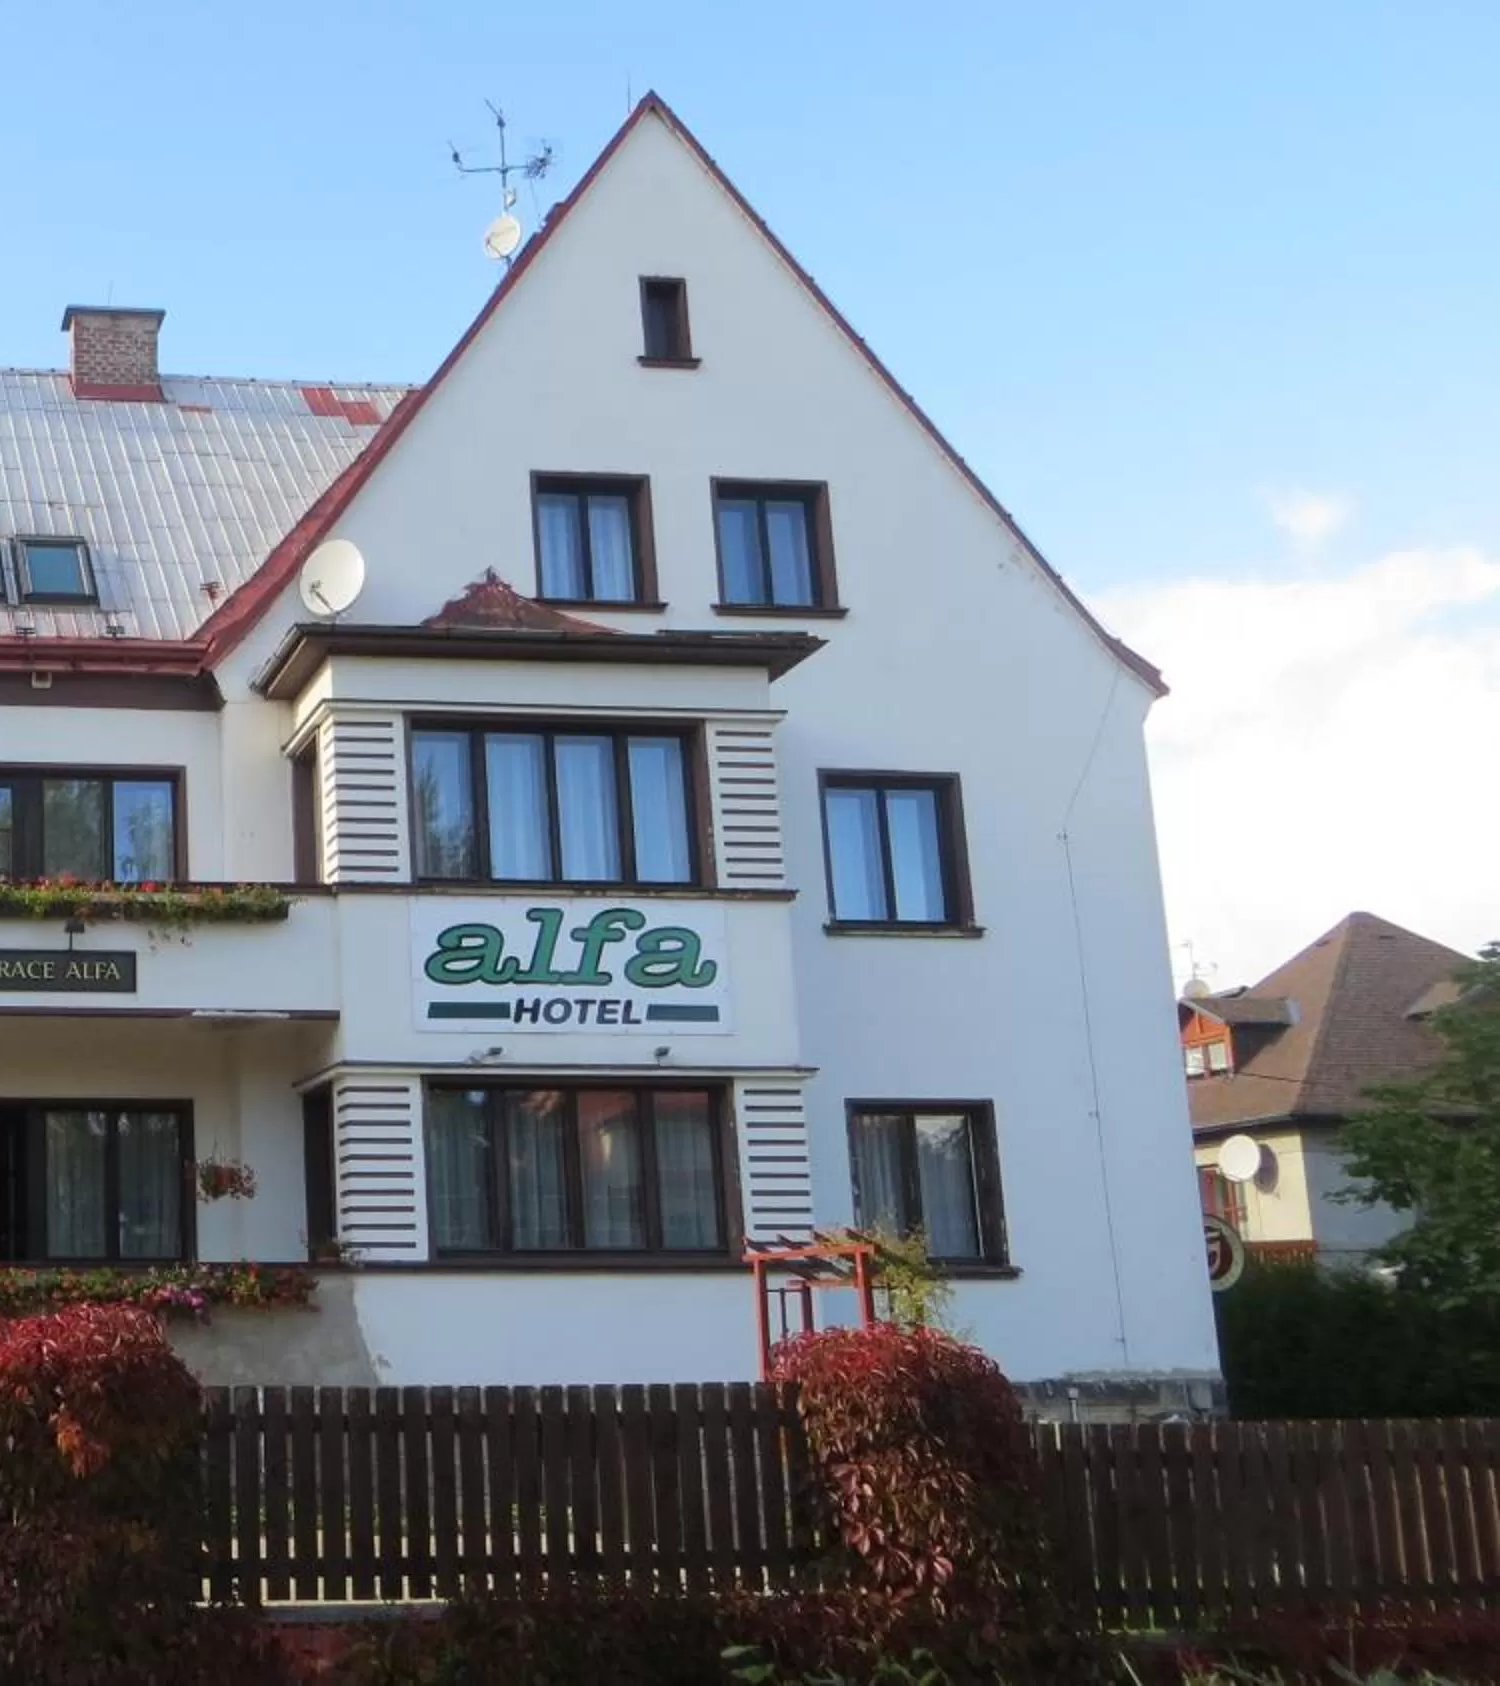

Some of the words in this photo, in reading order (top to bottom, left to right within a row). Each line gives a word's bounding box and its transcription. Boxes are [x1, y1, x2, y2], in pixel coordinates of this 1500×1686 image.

[424, 907, 718, 989] alfa
[65, 961, 122, 981] ALFA
[513, 998, 642, 1025] HOTEL
